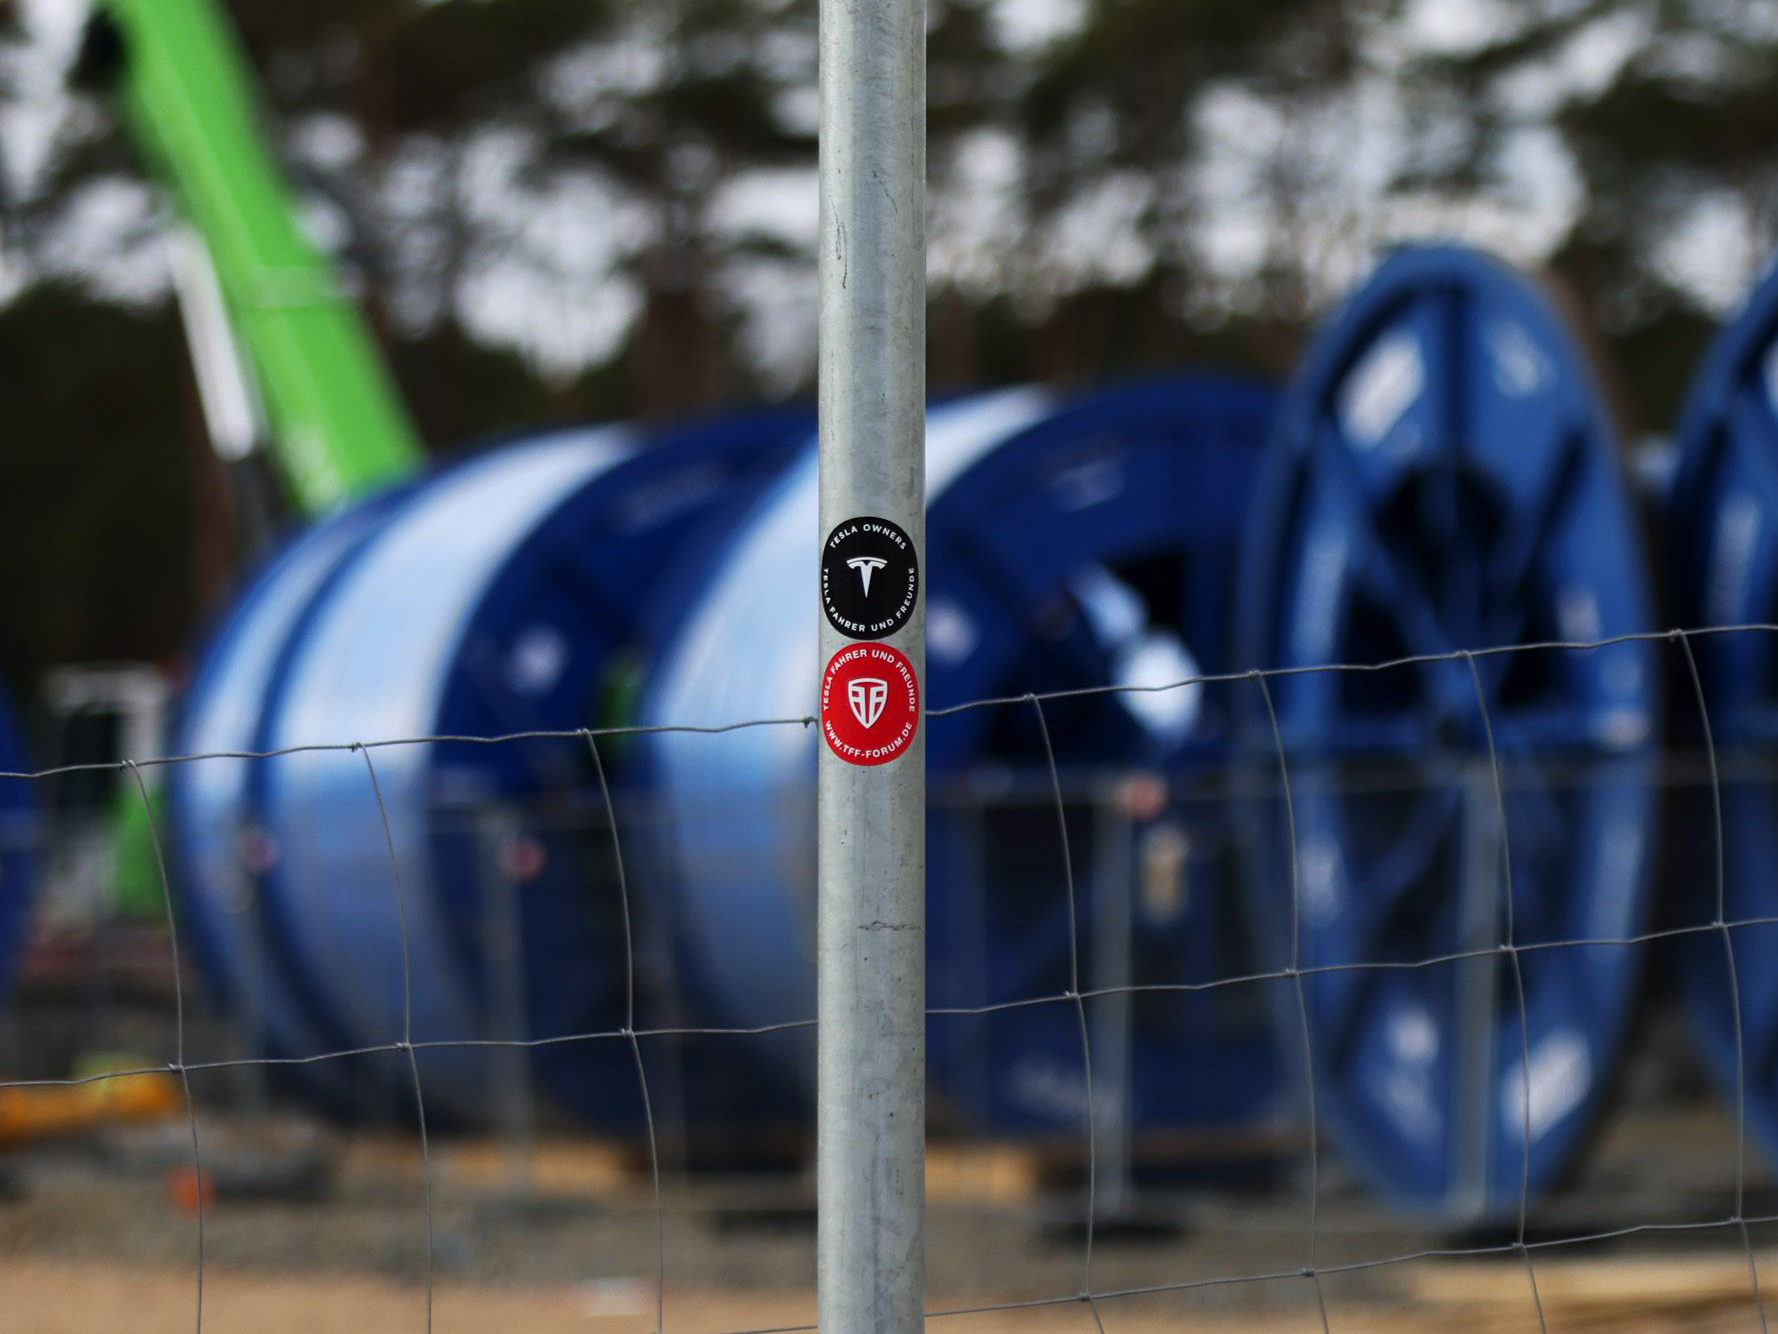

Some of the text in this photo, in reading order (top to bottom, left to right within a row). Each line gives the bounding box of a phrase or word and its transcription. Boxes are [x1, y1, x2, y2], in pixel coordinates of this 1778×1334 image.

[829, 523, 907, 550] TESLA OWNERS
[823, 567, 915, 632] TESLA FAHRER UND FREUNDE
[823, 649, 915, 712] TESLA FAHRER UND FREUNDE
[825, 720, 913, 759] WWW.TFF-FORUM.DE
